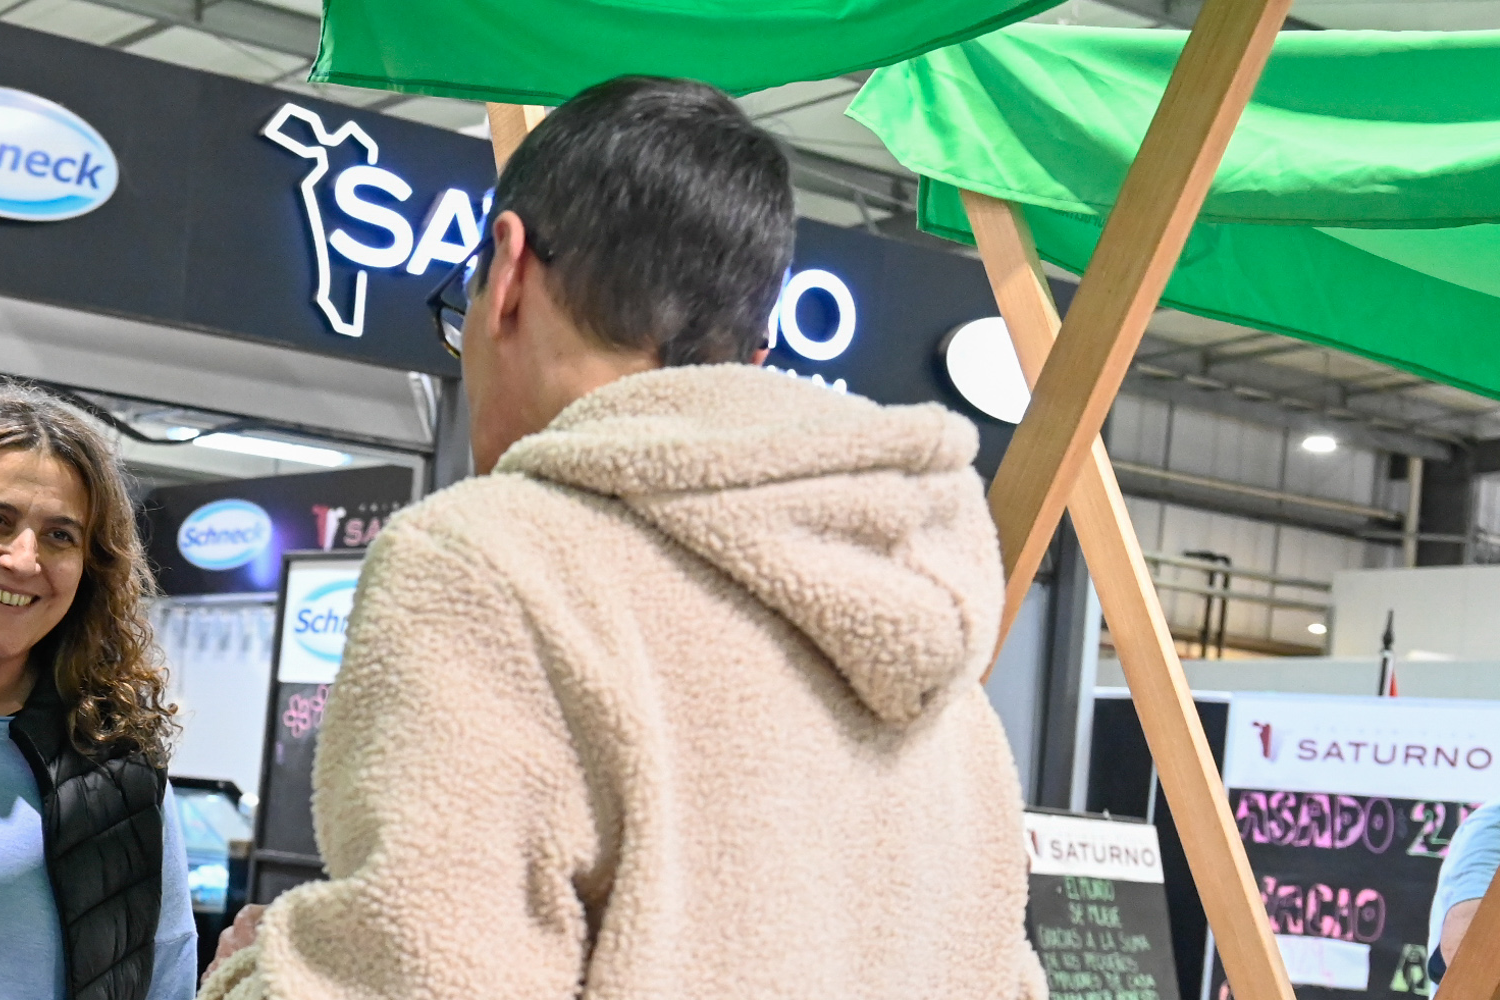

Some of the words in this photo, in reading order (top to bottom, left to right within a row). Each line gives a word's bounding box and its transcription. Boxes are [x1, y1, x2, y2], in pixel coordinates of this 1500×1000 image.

[182, 520, 263, 548] Schneck
[343, 514, 394, 547] SA
[1298, 738, 1493, 770] SATURNO
[1236, 790, 1395, 854] ASADO
[1050, 838, 1156, 868] SATURNO
